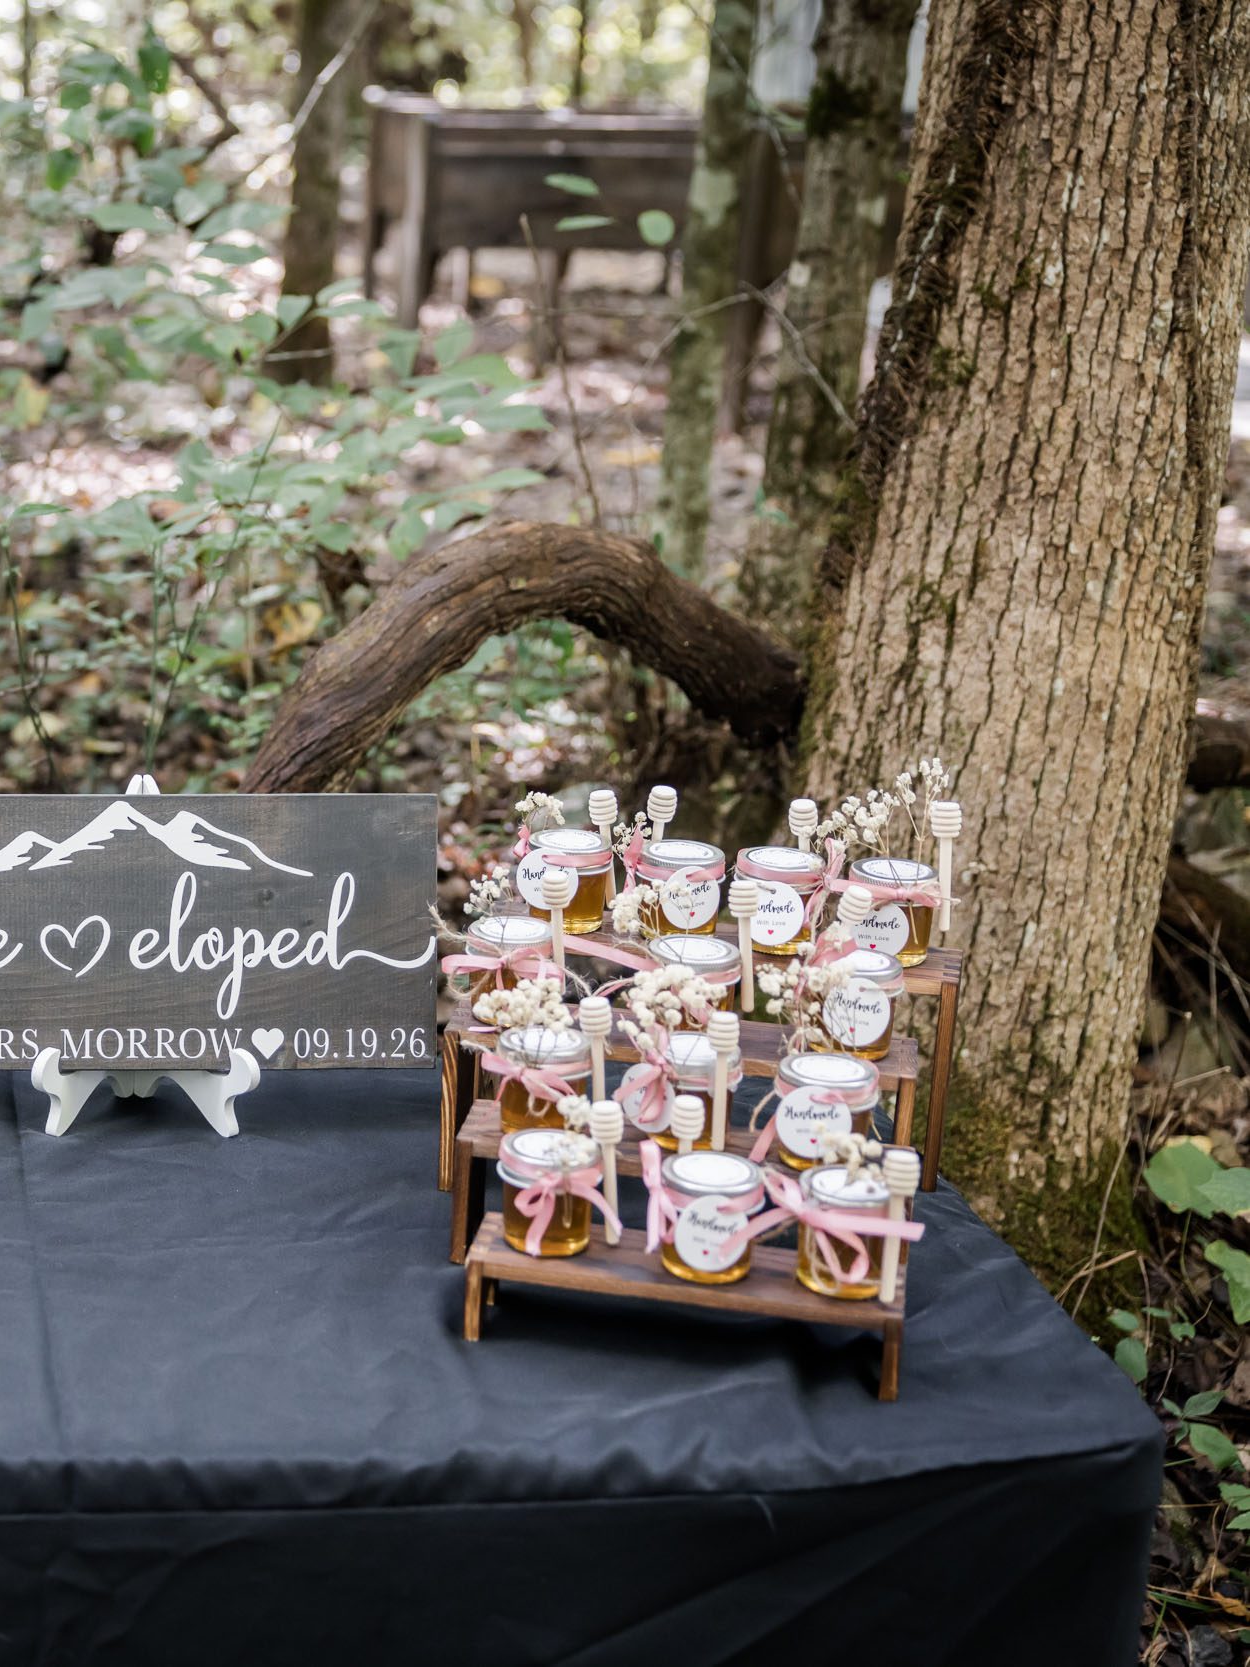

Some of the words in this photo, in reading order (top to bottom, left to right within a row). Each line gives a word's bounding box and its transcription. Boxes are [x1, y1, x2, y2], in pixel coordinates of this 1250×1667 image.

[128, 871, 437, 1020] eloped
[61, 1027, 243, 1060] MORROW
[294, 1027, 426, 1060] 09.19.26
[784, 1104, 840, 1121] Handmade
